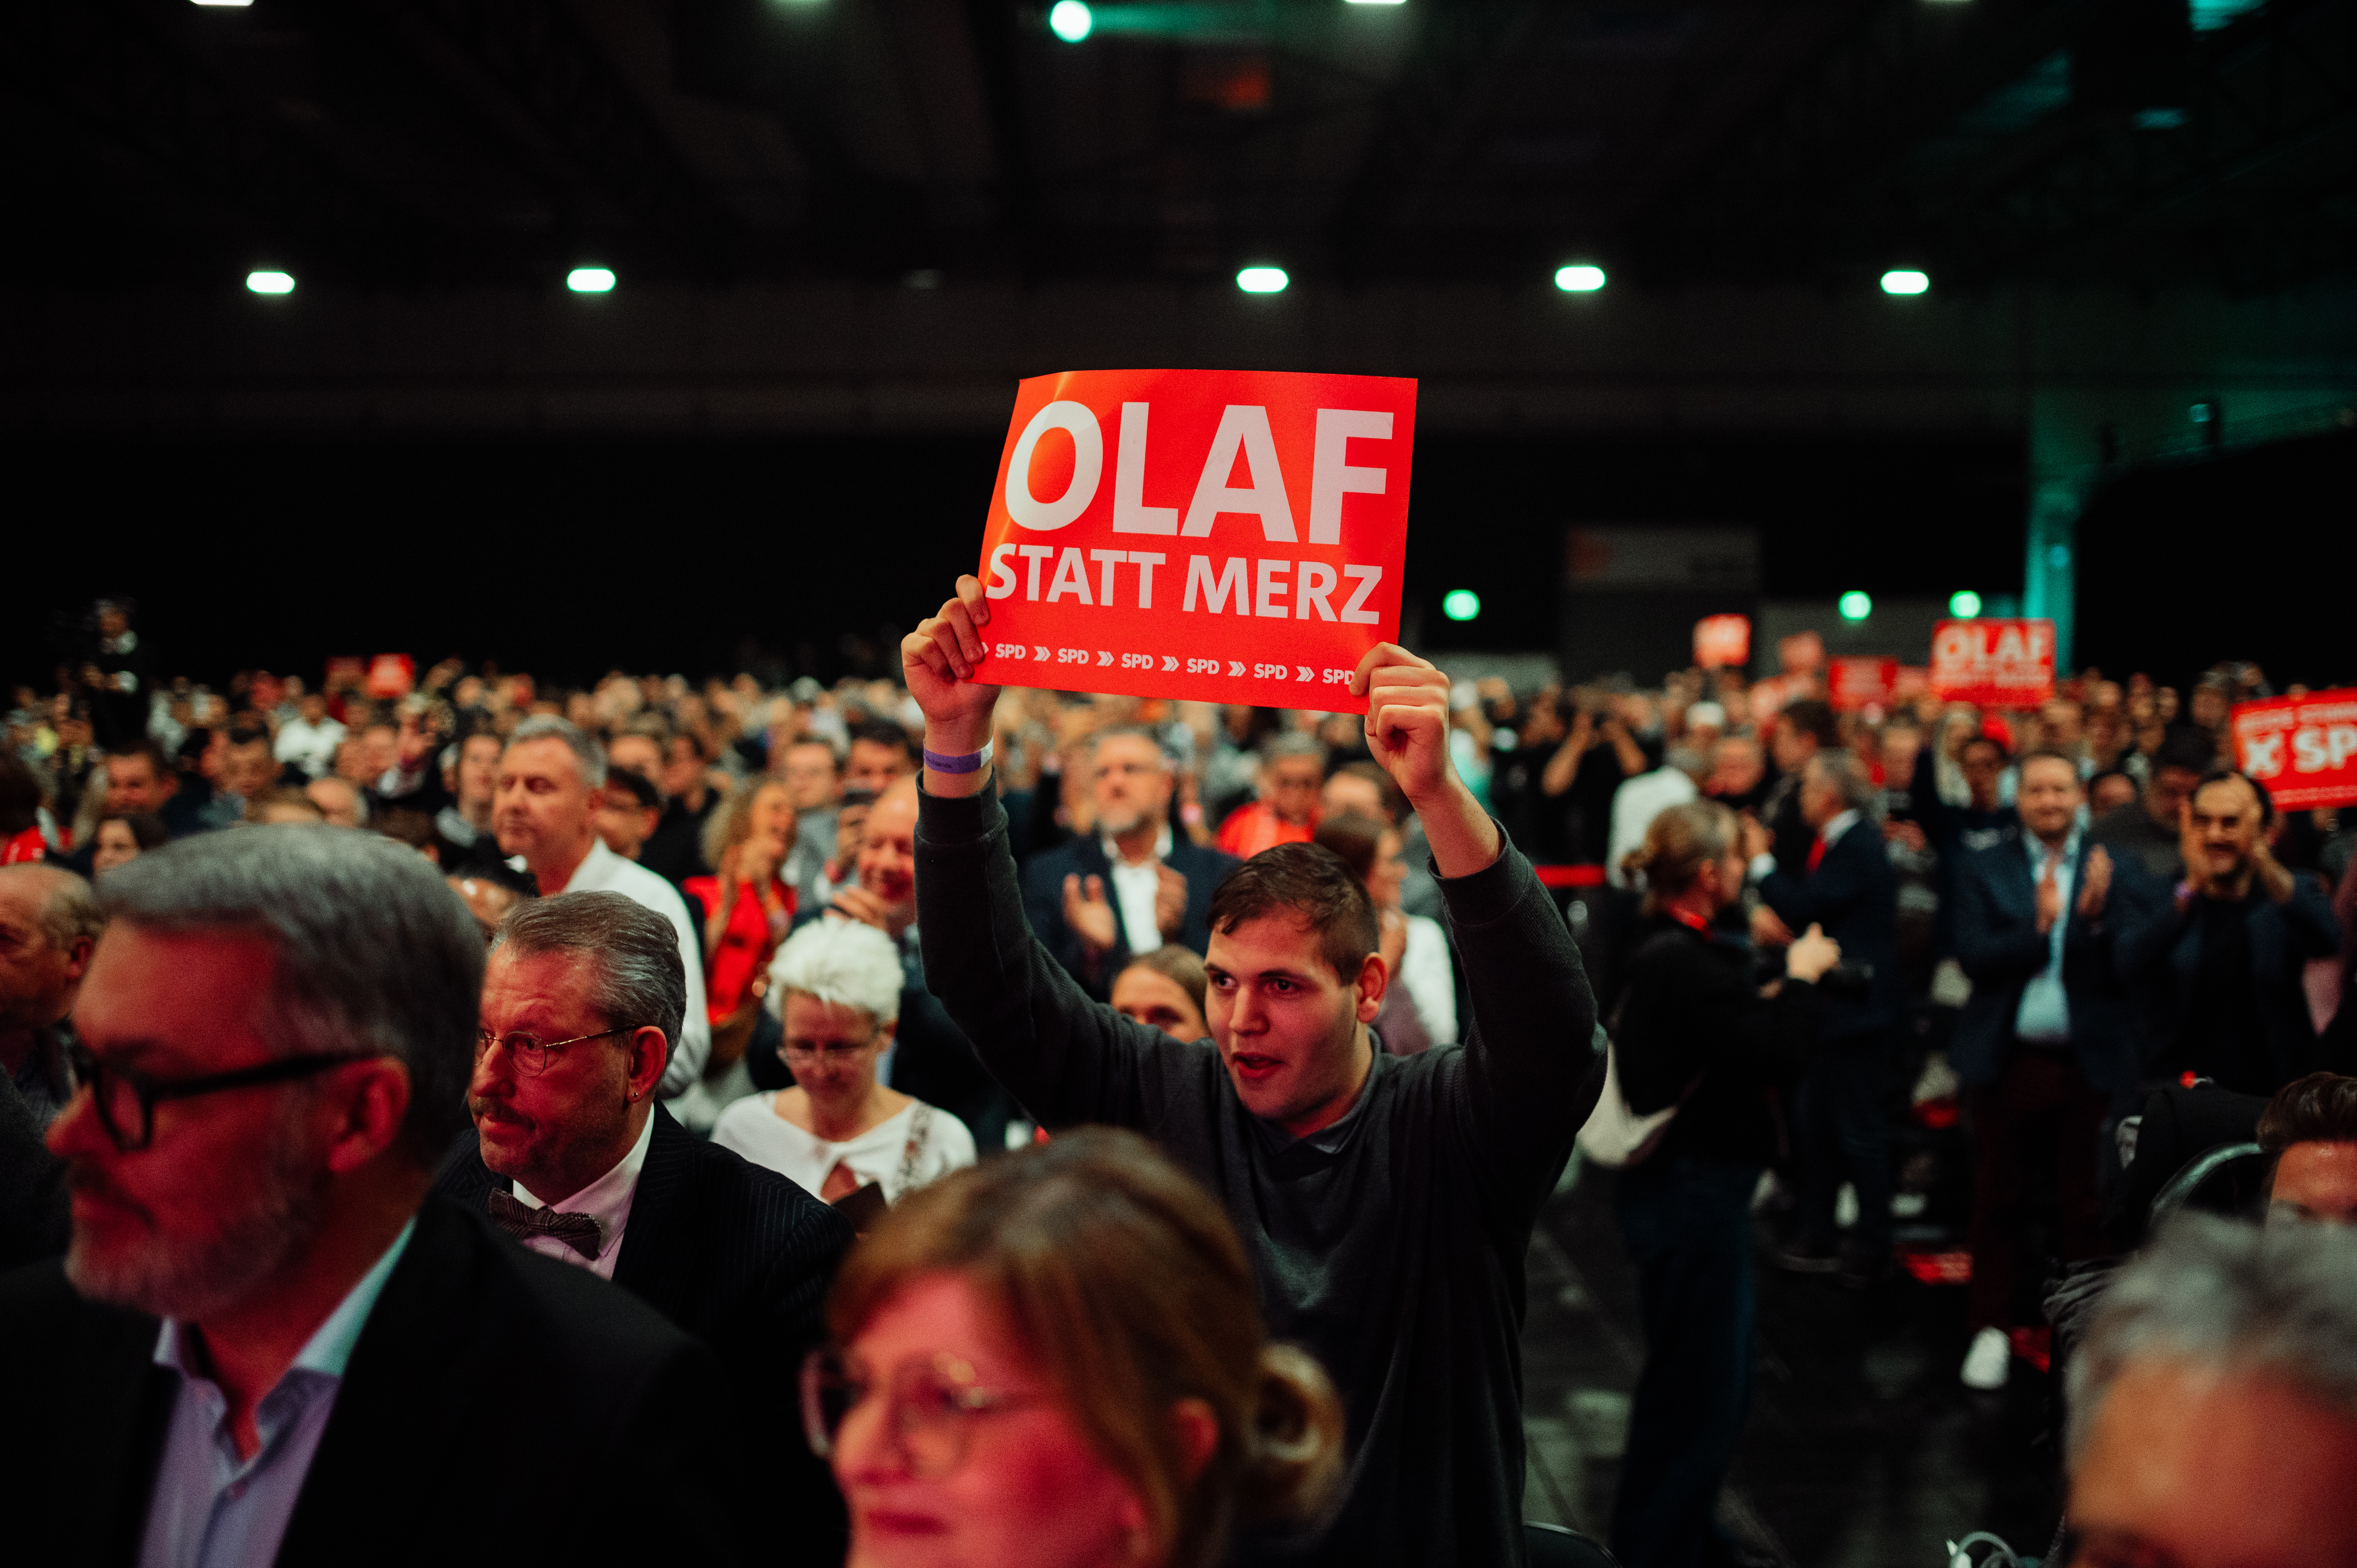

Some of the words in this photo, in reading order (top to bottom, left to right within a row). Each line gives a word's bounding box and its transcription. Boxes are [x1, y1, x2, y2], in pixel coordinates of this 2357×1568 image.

[1005, 400, 1394, 545] OLAF
[985, 543, 1166, 609] STATT
[1182, 555, 1383, 625] MERZ
[995, 643, 1026, 659] SPD
[1058, 648, 1089, 664] SPD
[1121, 653, 1154, 669] SPD
[1186, 658, 1220, 674] SPD
[1254, 663, 1288, 680] SPD
[1934, 625, 2052, 670] OLAF
